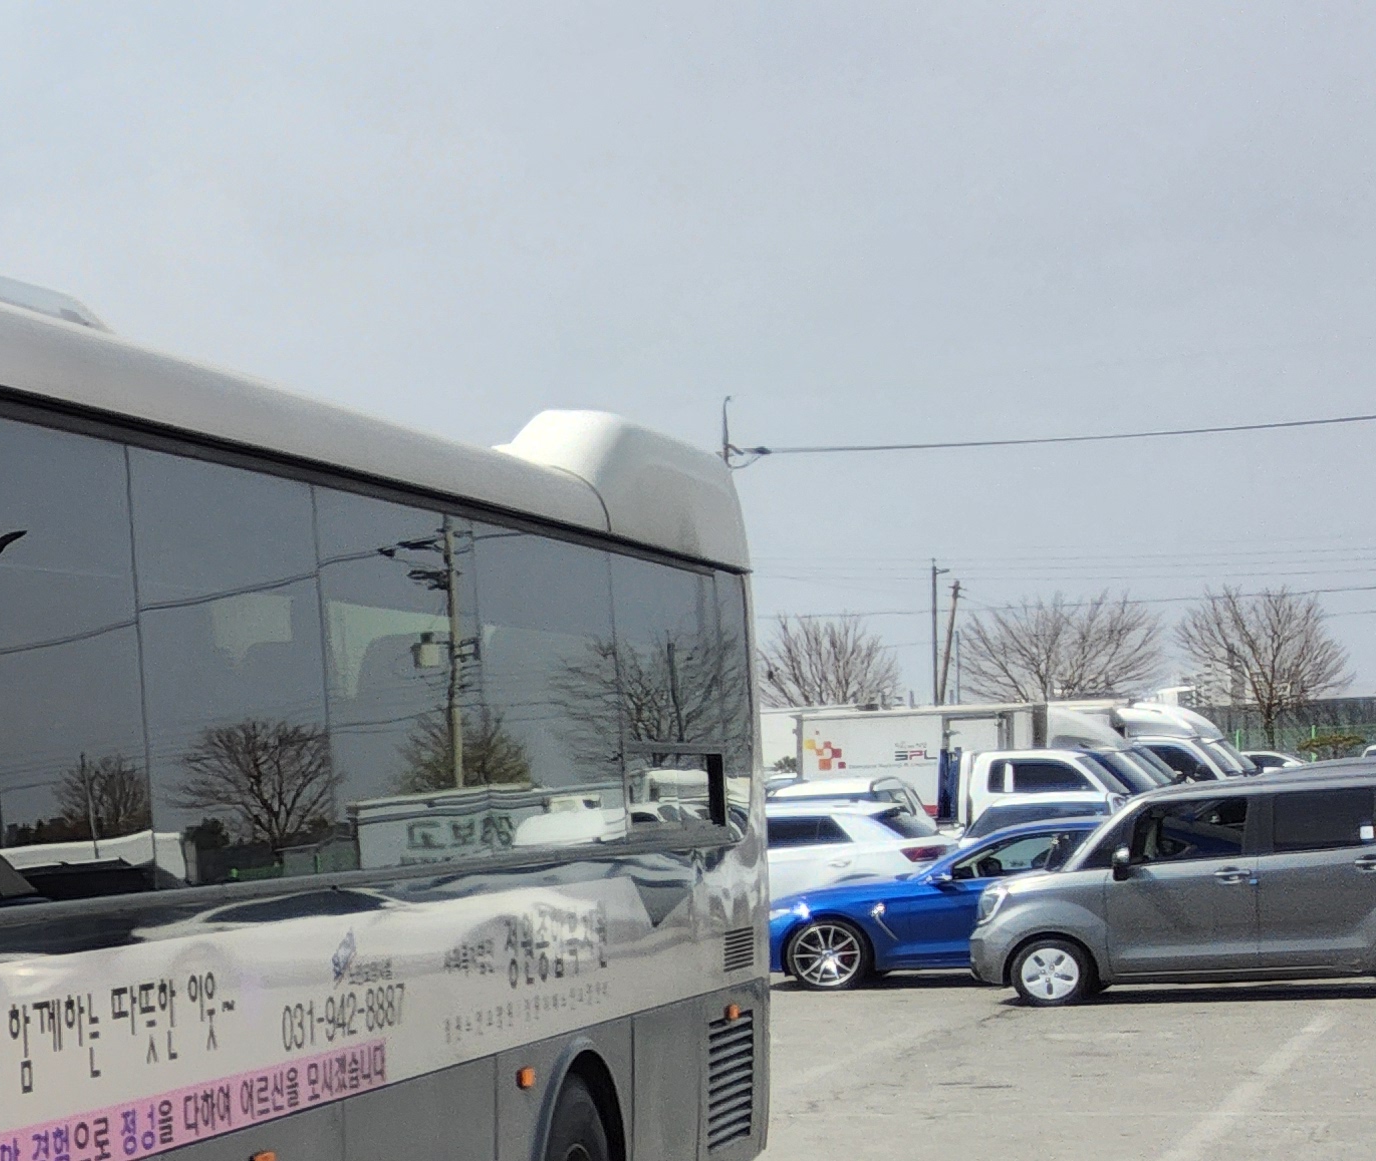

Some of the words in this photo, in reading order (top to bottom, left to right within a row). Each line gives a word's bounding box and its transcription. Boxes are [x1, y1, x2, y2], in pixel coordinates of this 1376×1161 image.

[894, 750, 938, 761] SPL
[8, 993, 101, 1094] 함께하는
[110, 978, 178, 1064] 따뜻한
[282, 983, 405, 1052] 031-942-8887
[183, 1083, 232, 1135] 다하여
[240, 1067, 300, 1120] 어르신을
[307, 1043, 387, 1102] 모시겠습니다
